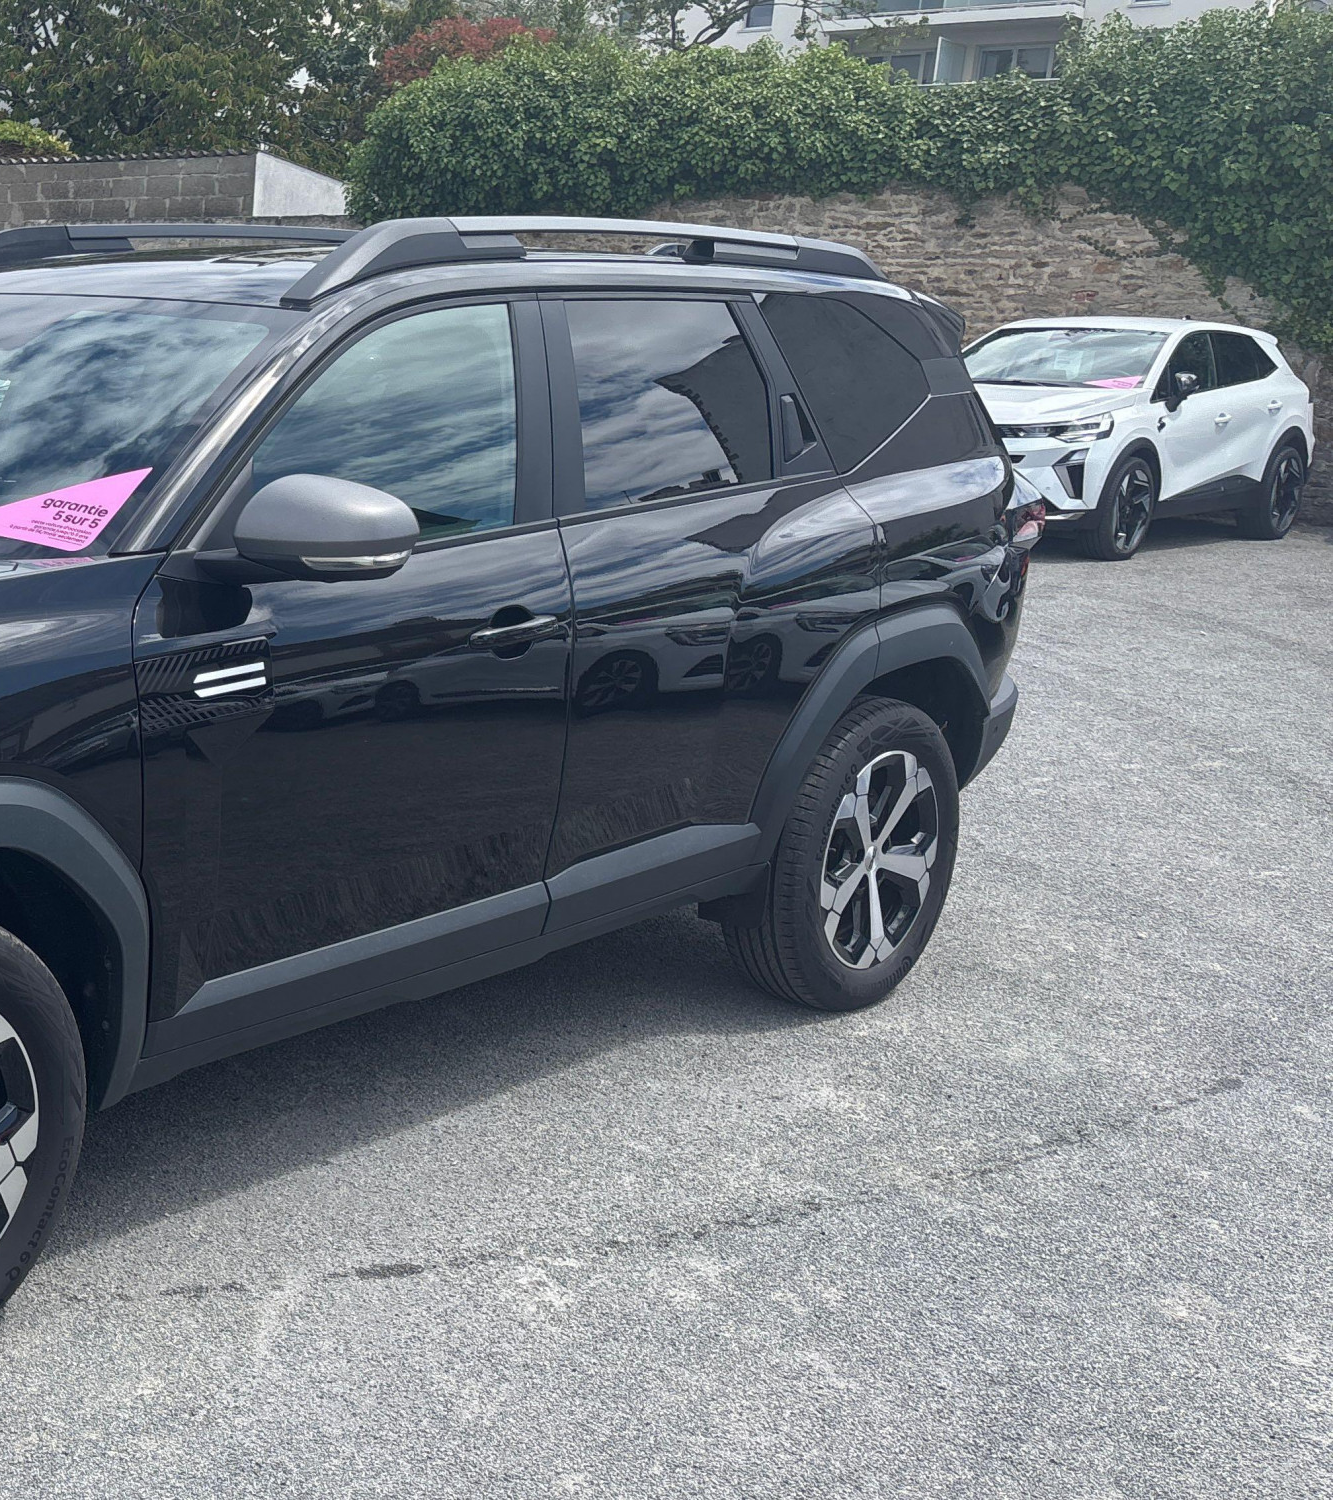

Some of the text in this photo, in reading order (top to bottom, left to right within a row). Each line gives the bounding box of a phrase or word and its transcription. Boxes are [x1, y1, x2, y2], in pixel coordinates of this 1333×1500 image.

[41, 498, 109, 517] garantie
[52, 510, 102, 529] 5 sur 5
[19, 1251, 31, 1265] 6
[5, 1265, 20, 1281] Q
